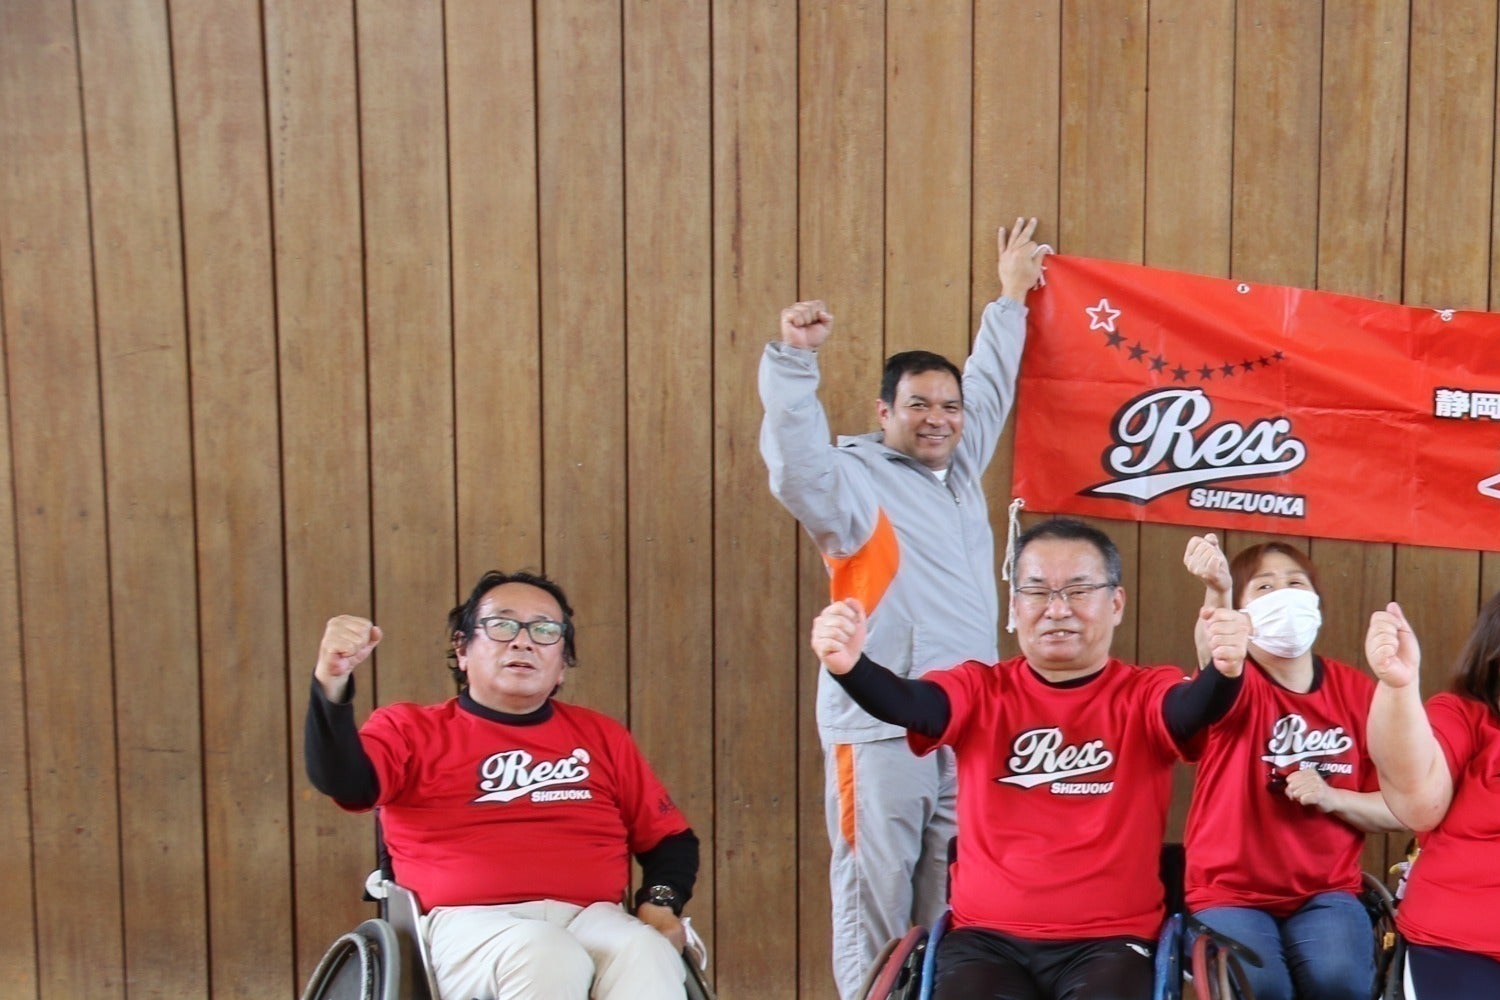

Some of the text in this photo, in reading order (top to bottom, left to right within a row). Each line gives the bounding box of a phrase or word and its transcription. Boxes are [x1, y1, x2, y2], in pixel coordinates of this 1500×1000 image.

[1108, 388, 1307, 474] Rex
[1188, 487, 1305, 517] SHIZUOKA
[1009, 727, 1114, 773] Rex
[1268, 713, 1353, 754] Rex
[480, 749, 590, 792] Rex
[531, 789, 593, 802] SHIZUOKA
